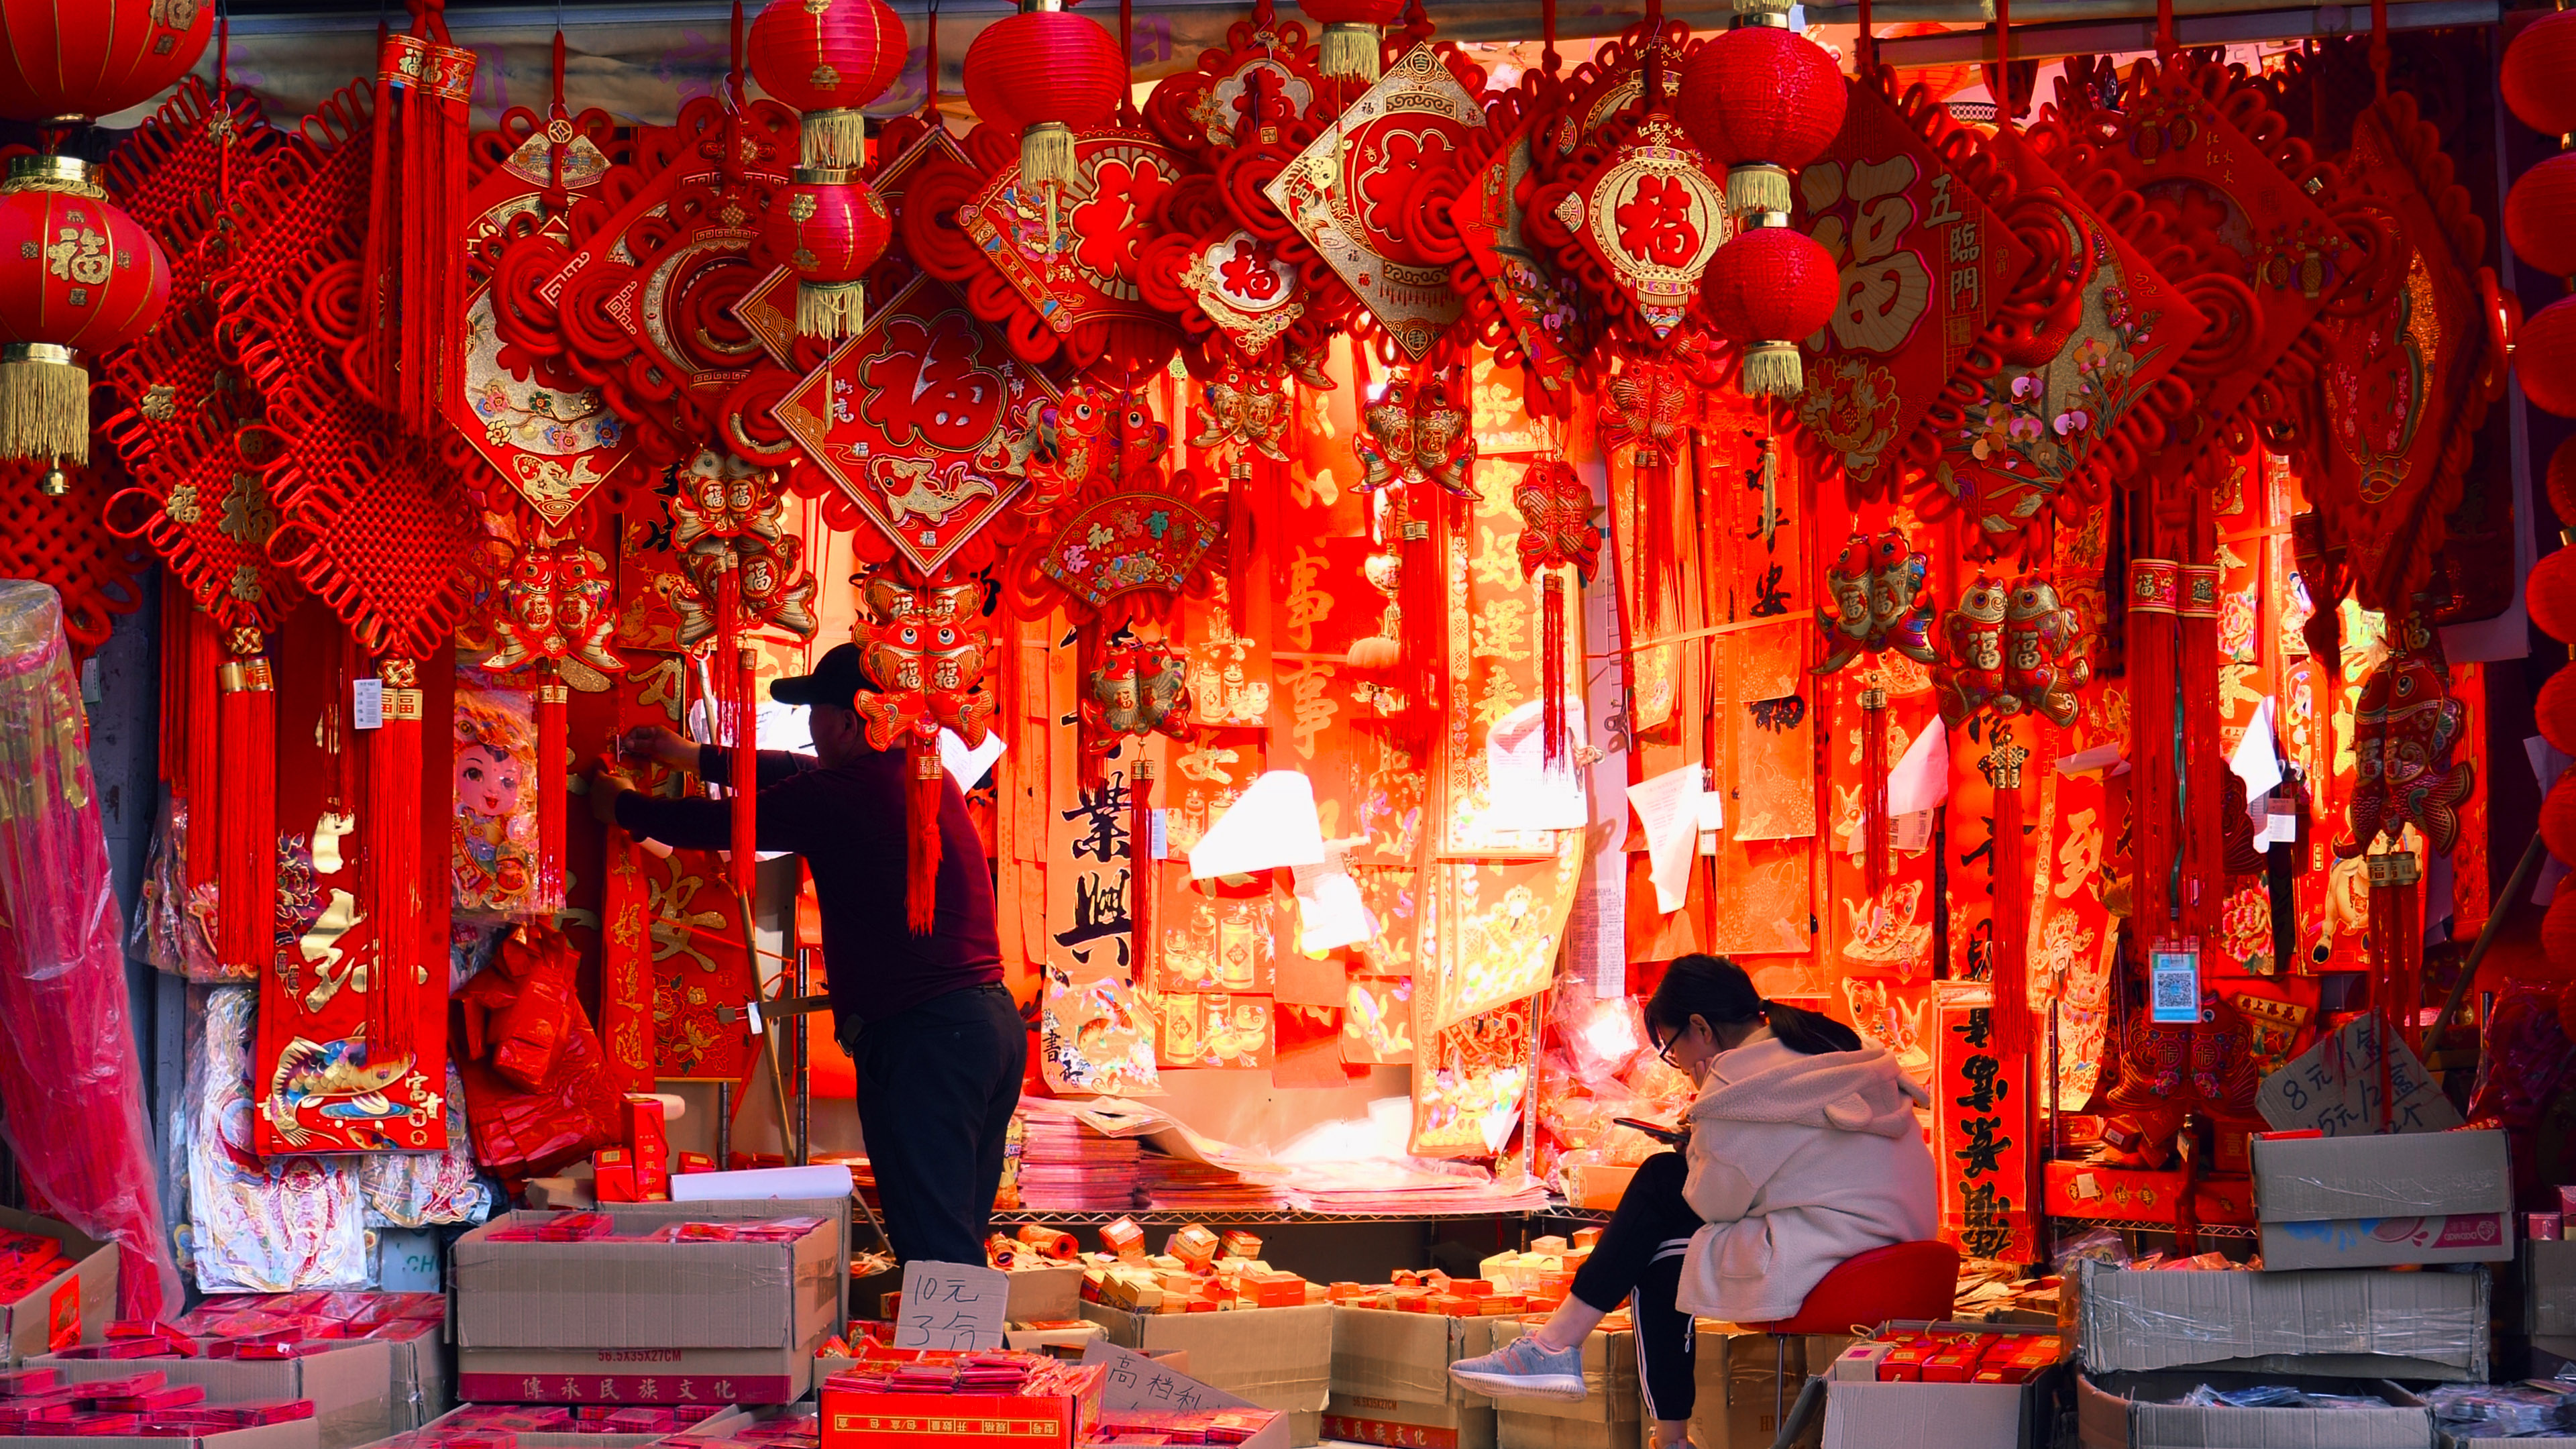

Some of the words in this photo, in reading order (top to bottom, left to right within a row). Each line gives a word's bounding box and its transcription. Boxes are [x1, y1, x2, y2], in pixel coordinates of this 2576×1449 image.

[1413, 53, 1432, 74] 吉
[1637, 121, 1685, 140] 红红火火
[1617, 174, 1701, 267] 福
[47, 228, 110, 284] 福
[1801, 154, 1930, 354] 福
[1923, 174, 1980, 312] 五臨門
[1220, 239, 1281, 300] 福
[1409, 329, 1427, 347] 祥
[142, 384, 176, 421] 福
[167, 484, 202, 523] 福
[219, 472, 276, 545] 福
[704, 485, 725, 508] 福
[730, 485, 749, 508] 福
[231, 564, 262, 602] 福
[744, 561, 772, 592] 福
[1841, 590, 1864, 618] 福
[1968, 631, 2001, 671] 福
[896, 661, 920, 689] 福
[934, 661, 960, 690] 福
[405, 1071, 444, 1119] 富貴
[914, 1275, 979, 1305] 10元
[522, 1376, 737, 1401] 傳承民族文化
[930, 1419, 953, 1432] 数量
[984, 1421, 1008, 1434] 规格
[1032, 1422, 1055, 1434] 型号
